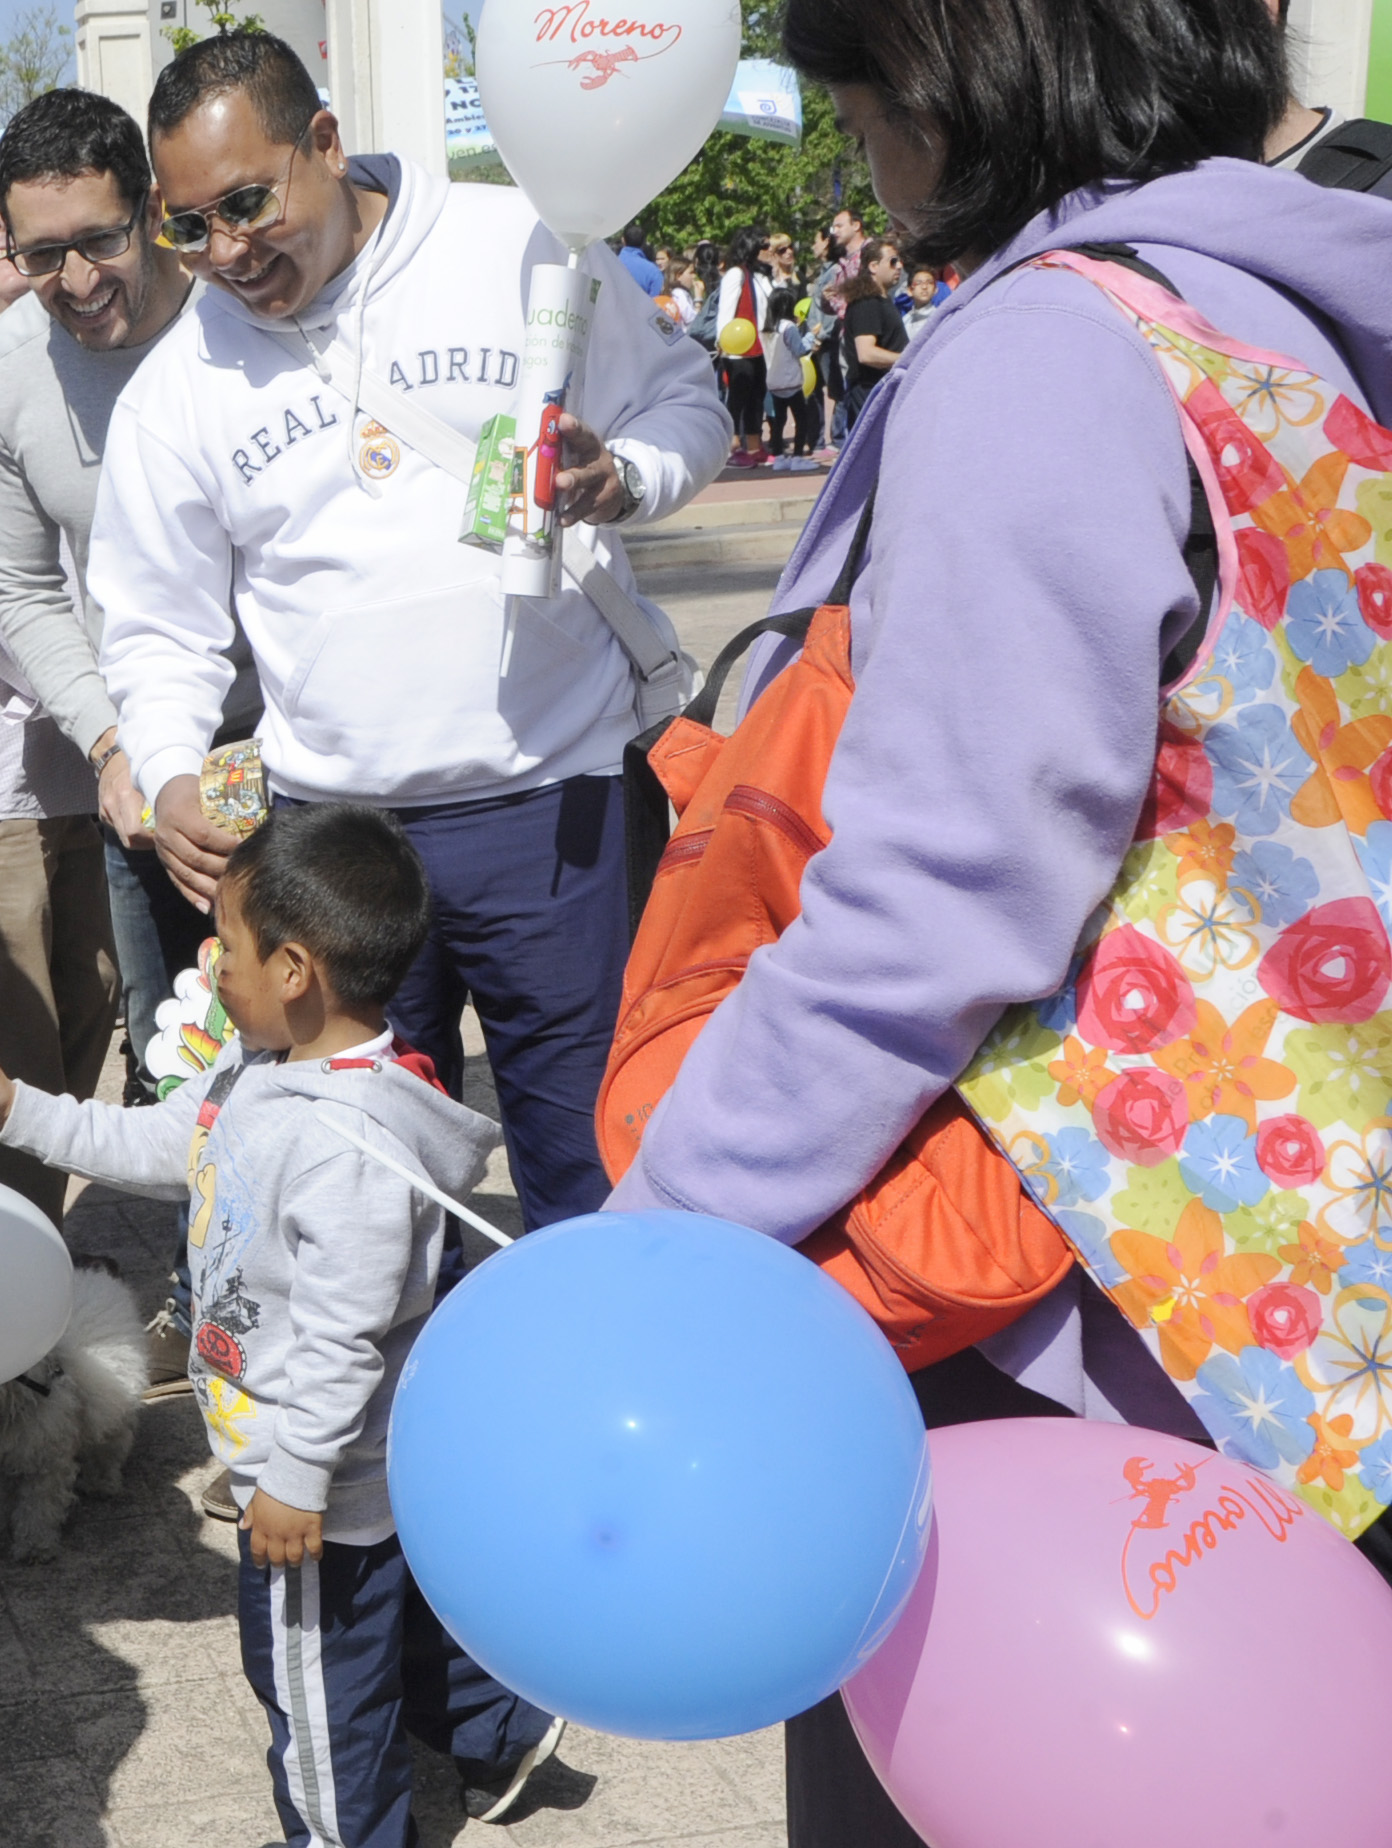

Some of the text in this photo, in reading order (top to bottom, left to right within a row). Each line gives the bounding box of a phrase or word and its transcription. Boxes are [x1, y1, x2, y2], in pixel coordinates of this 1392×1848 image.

[533, 0, 682, 44] Moreno
[231, 346, 519, 485] REAL ADRID
[1146, 1475, 1305, 1604] Moreno
